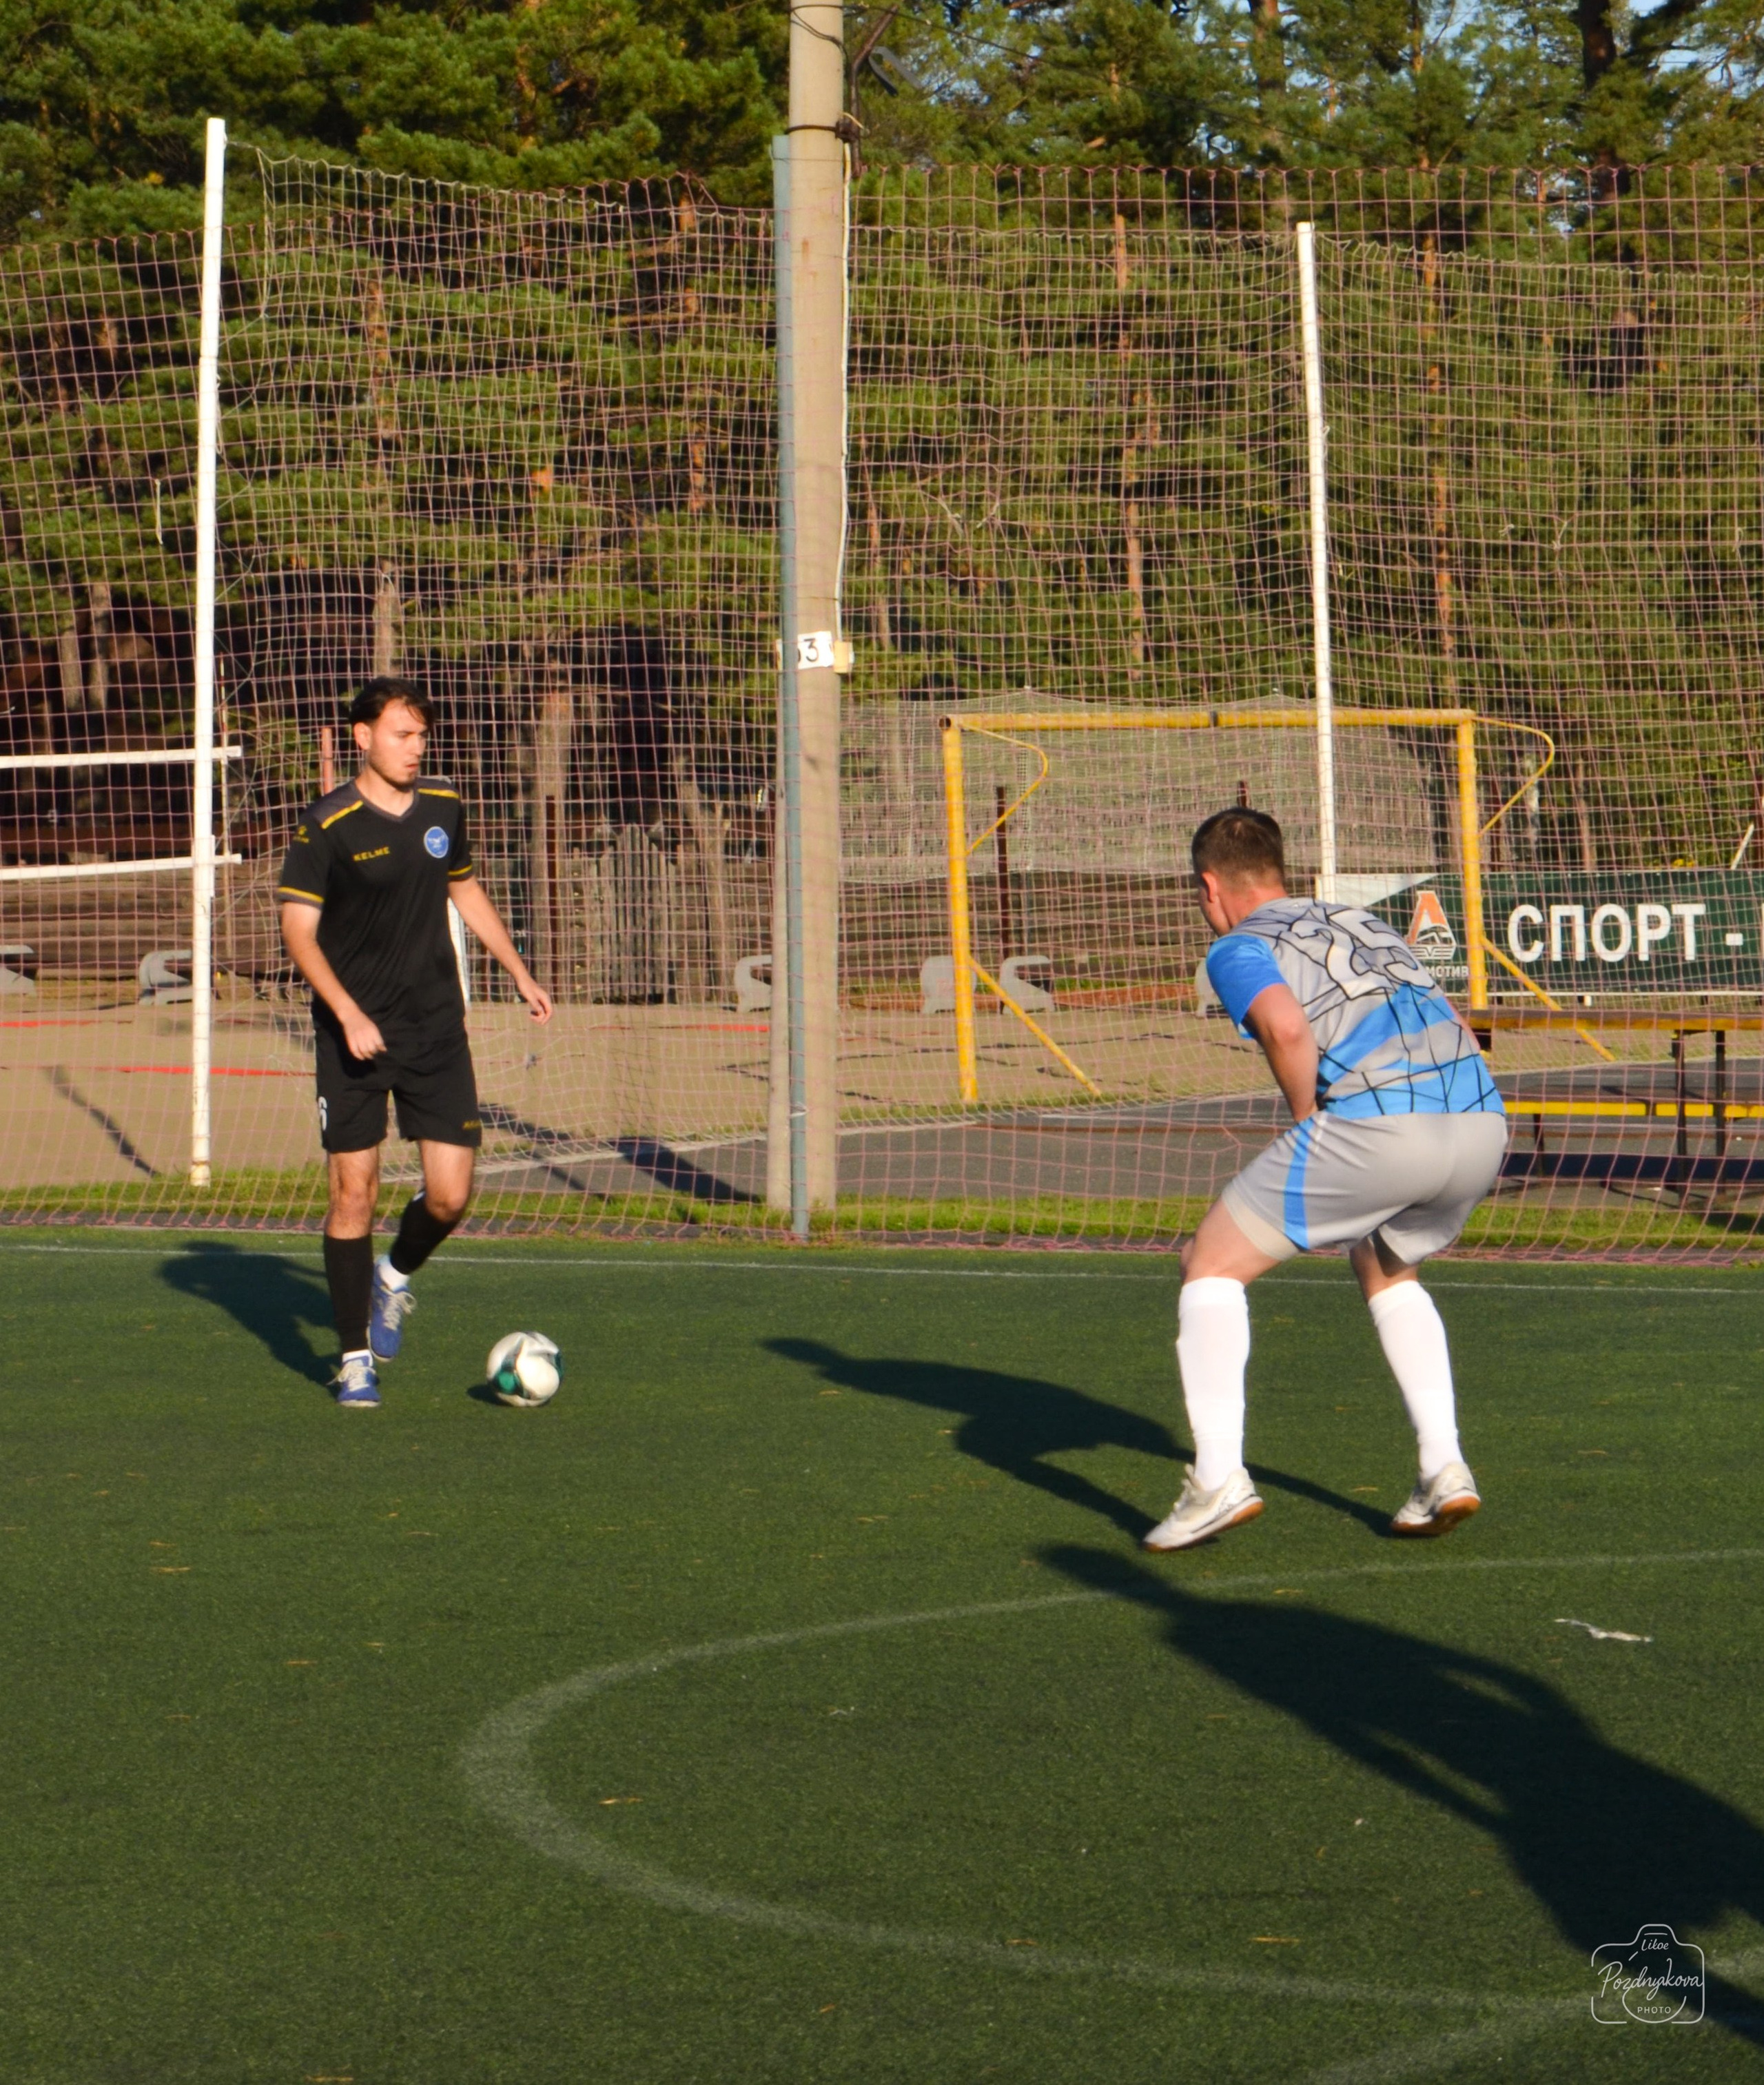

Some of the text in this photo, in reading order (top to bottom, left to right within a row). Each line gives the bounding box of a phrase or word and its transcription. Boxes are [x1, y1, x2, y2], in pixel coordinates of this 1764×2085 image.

[797, 637, 819, 662] 3
[353, 846, 390, 862] KELME
[1508, 903, 1707, 963] СПОРТ
[1289, 908, 1436, 1001] 25
[1425, 965, 1469, 978] МОТИВ
